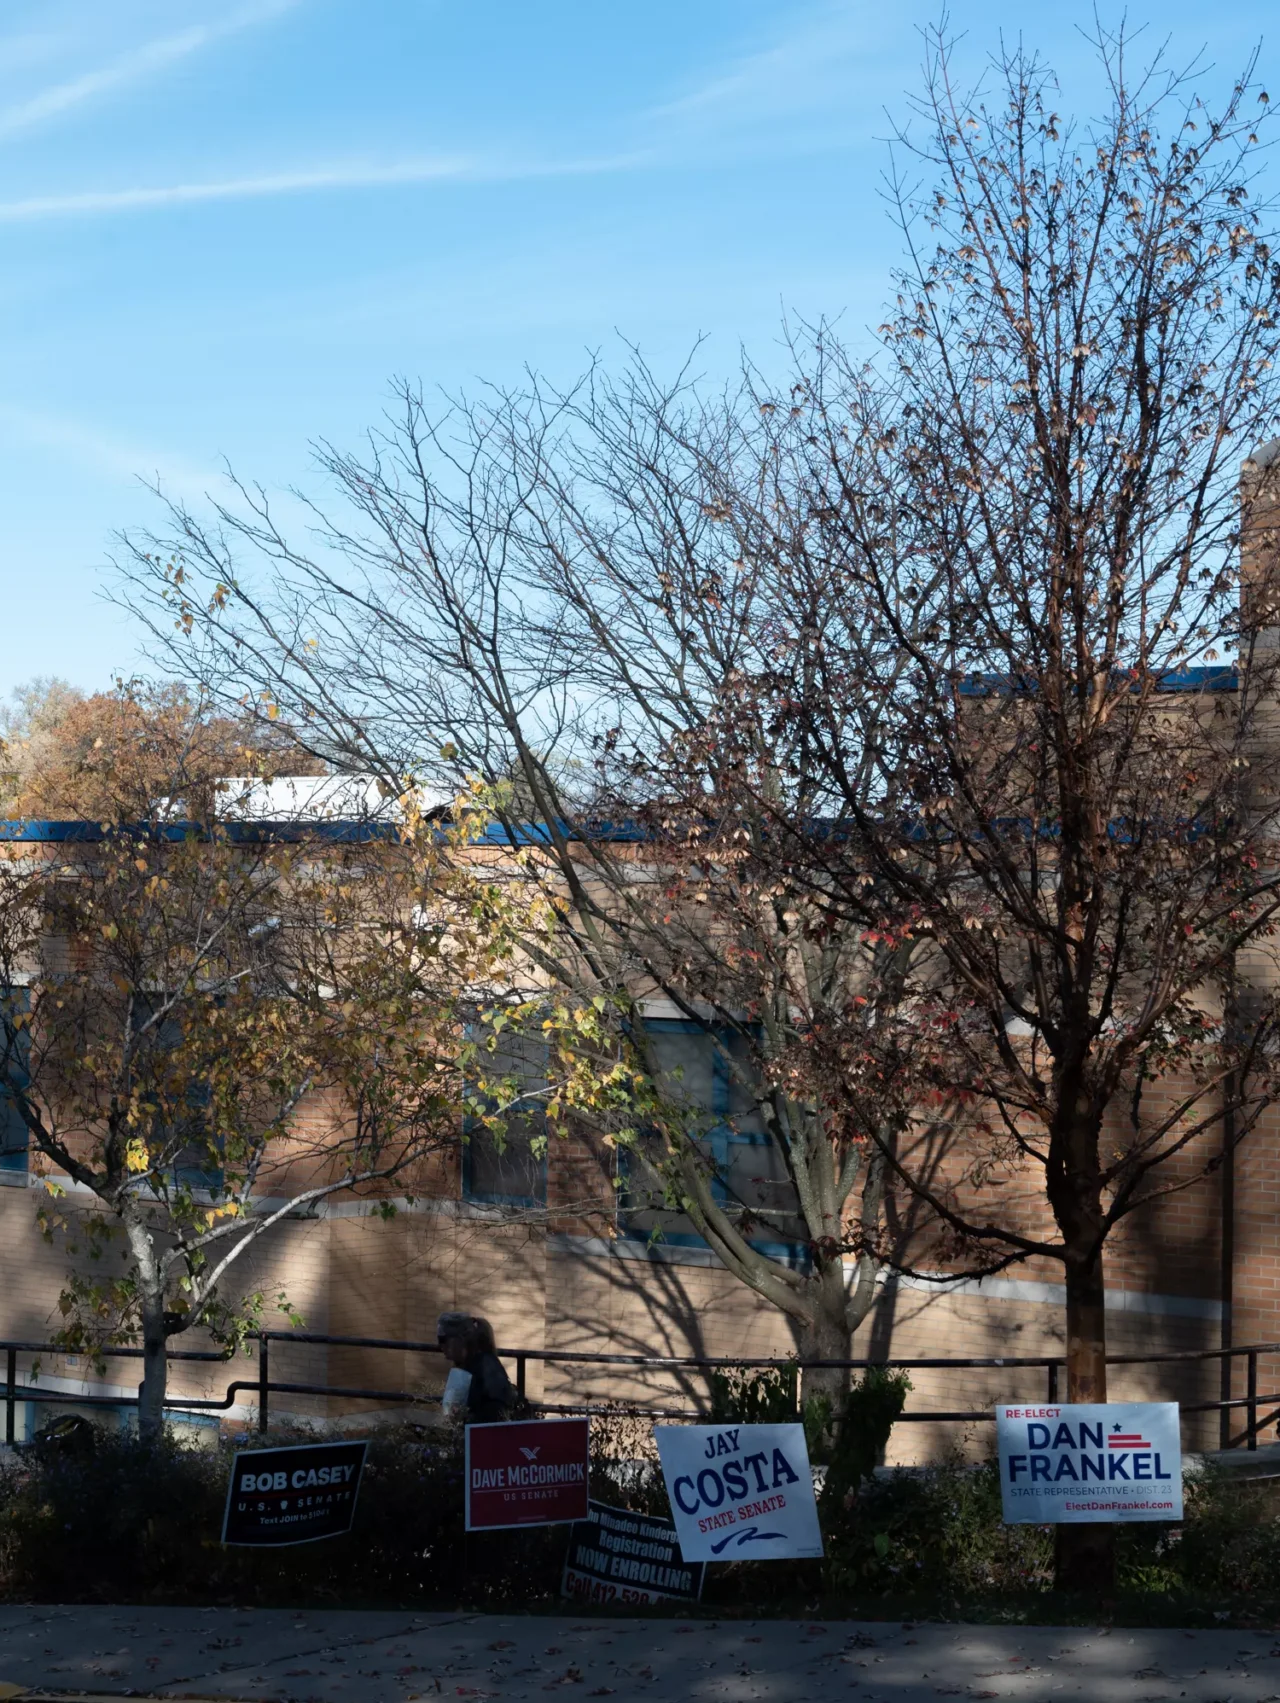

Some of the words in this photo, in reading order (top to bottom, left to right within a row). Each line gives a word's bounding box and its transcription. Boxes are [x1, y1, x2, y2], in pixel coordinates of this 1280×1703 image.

[1005, 1408, 1061, 1418] RE-ELECT
[704, 1429, 740, 1459] JAY
[1027, 1422, 1104, 1450] DAN
[240, 1472, 288, 1492] BOB
[291, 1464, 356, 1489] CASEY
[472, 1468, 505, 1489] DAVE
[1008, 1453, 1171, 1482] FRANKEL
[673, 1448, 799, 1515] COSTA
[1011, 1487, 1042, 1496] STATE
[1044, 1485, 1129, 1496] REPRESENTATIVE
[1136, 1485, 1160, 1495] DIST.
[1161, 1485, 1172, 1494] 23
[297, 1491, 352, 1508] SENATE
[503, 1492, 516, 1501] US
[521, 1489, 559, 1500] SENATE
[1065, 1501, 1173, 1511] ElectDanFrankel.com
[259, 1515, 279, 1525] Text
[279, 1513, 298, 1524] JOIN
[300, 1513, 308, 1521] to
[599, 1512, 638, 1535] Minadeo
[698, 1510, 736, 1534] STATE
[738, 1494, 786, 1520] SENATE
[599, 1529, 673, 1562] Registration
[575, 1544, 609, 1574] NOW
[610, 1556, 692, 1592] ENROLLING
